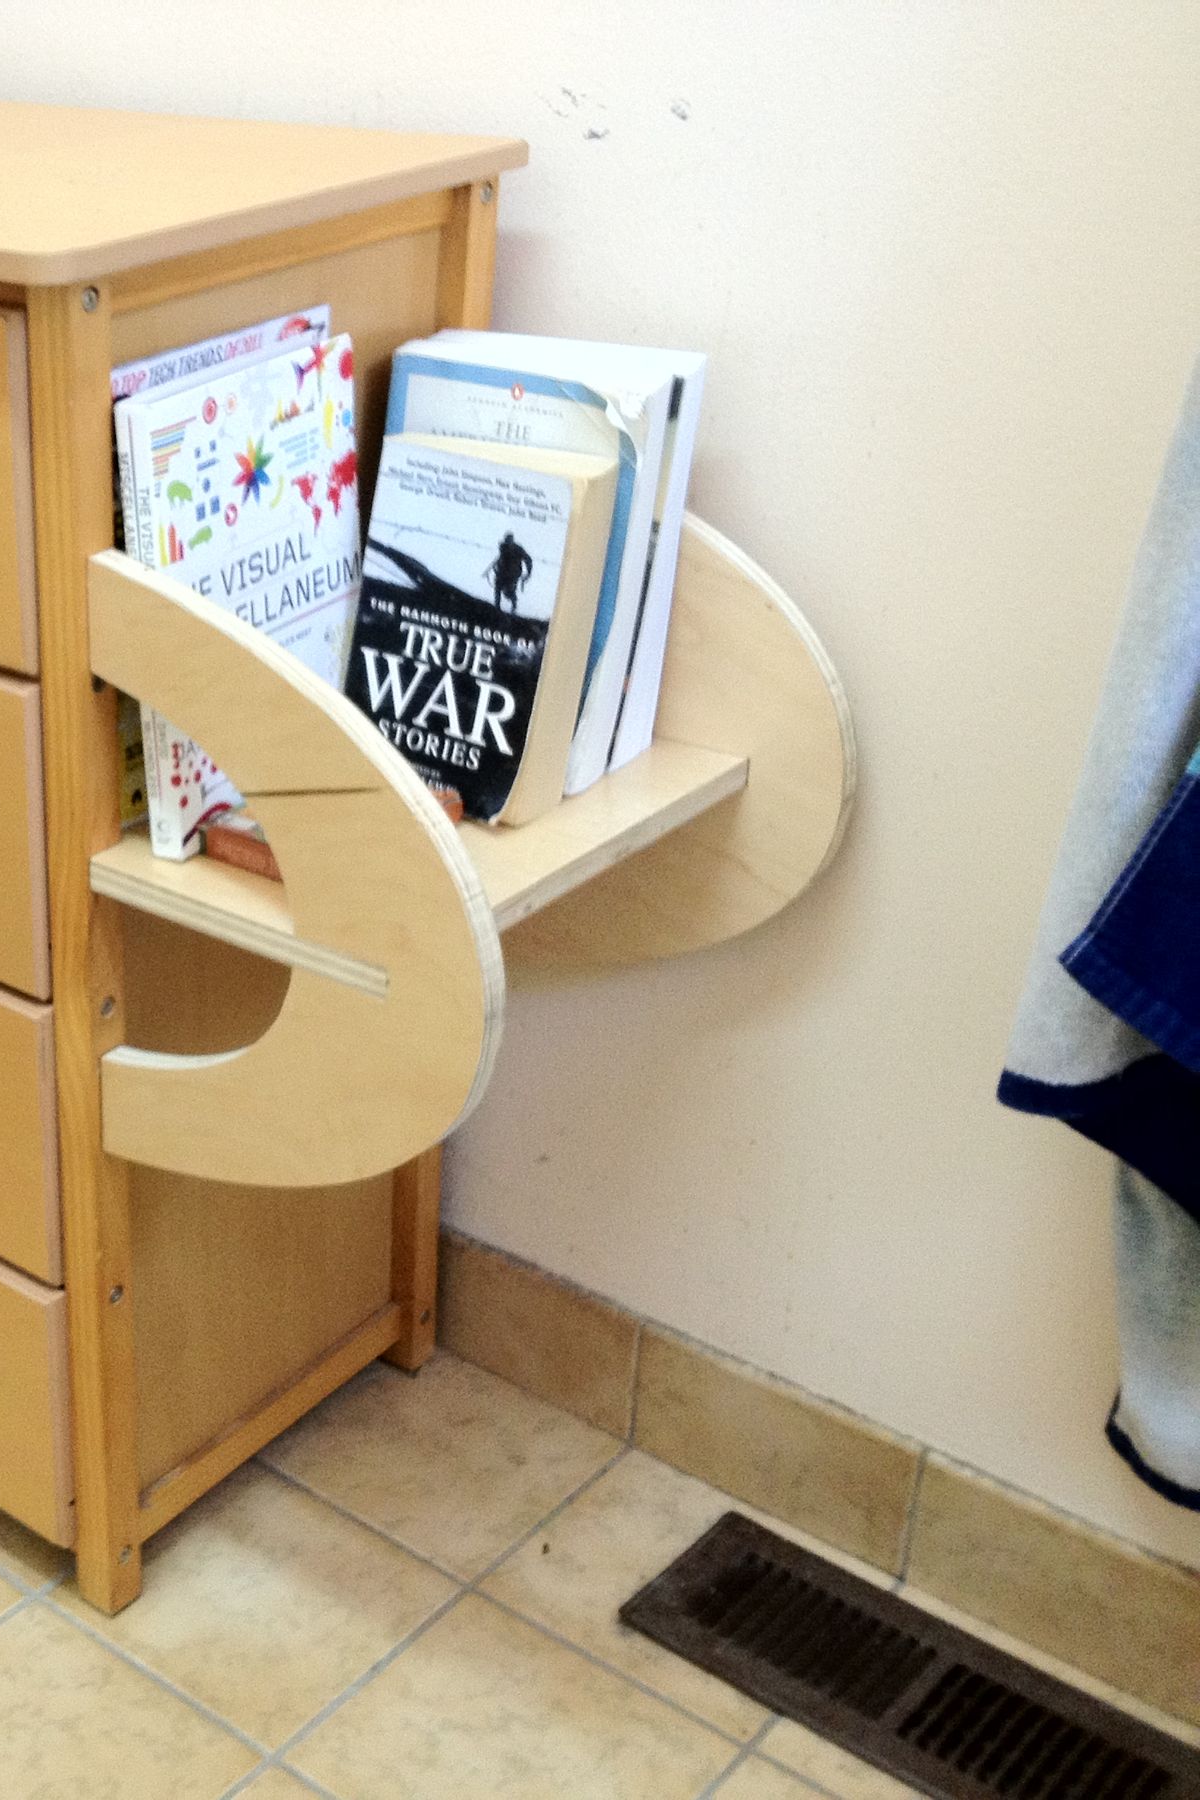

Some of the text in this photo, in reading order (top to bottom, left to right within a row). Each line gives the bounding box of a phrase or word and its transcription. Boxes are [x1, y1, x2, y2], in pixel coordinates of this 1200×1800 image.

[121, 369, 146, 395] TOP
[149, 358, 177, 388] TECH
[178, 344, 224, 377] TRENDS
[495, 419, 534, 440] THE
[140, 487, 152, 517] THE
[220, 531, 312, 597] VISUAL
[236, 551, 363, 629] ELLANEUM
[370, 597, 537, 655] THE MAMMOTH BOOK OF
[399, 620, 497, 681] TRUE
[360, 645, 514, 757] WAR
[378, 717, 482, 771] STORIES
